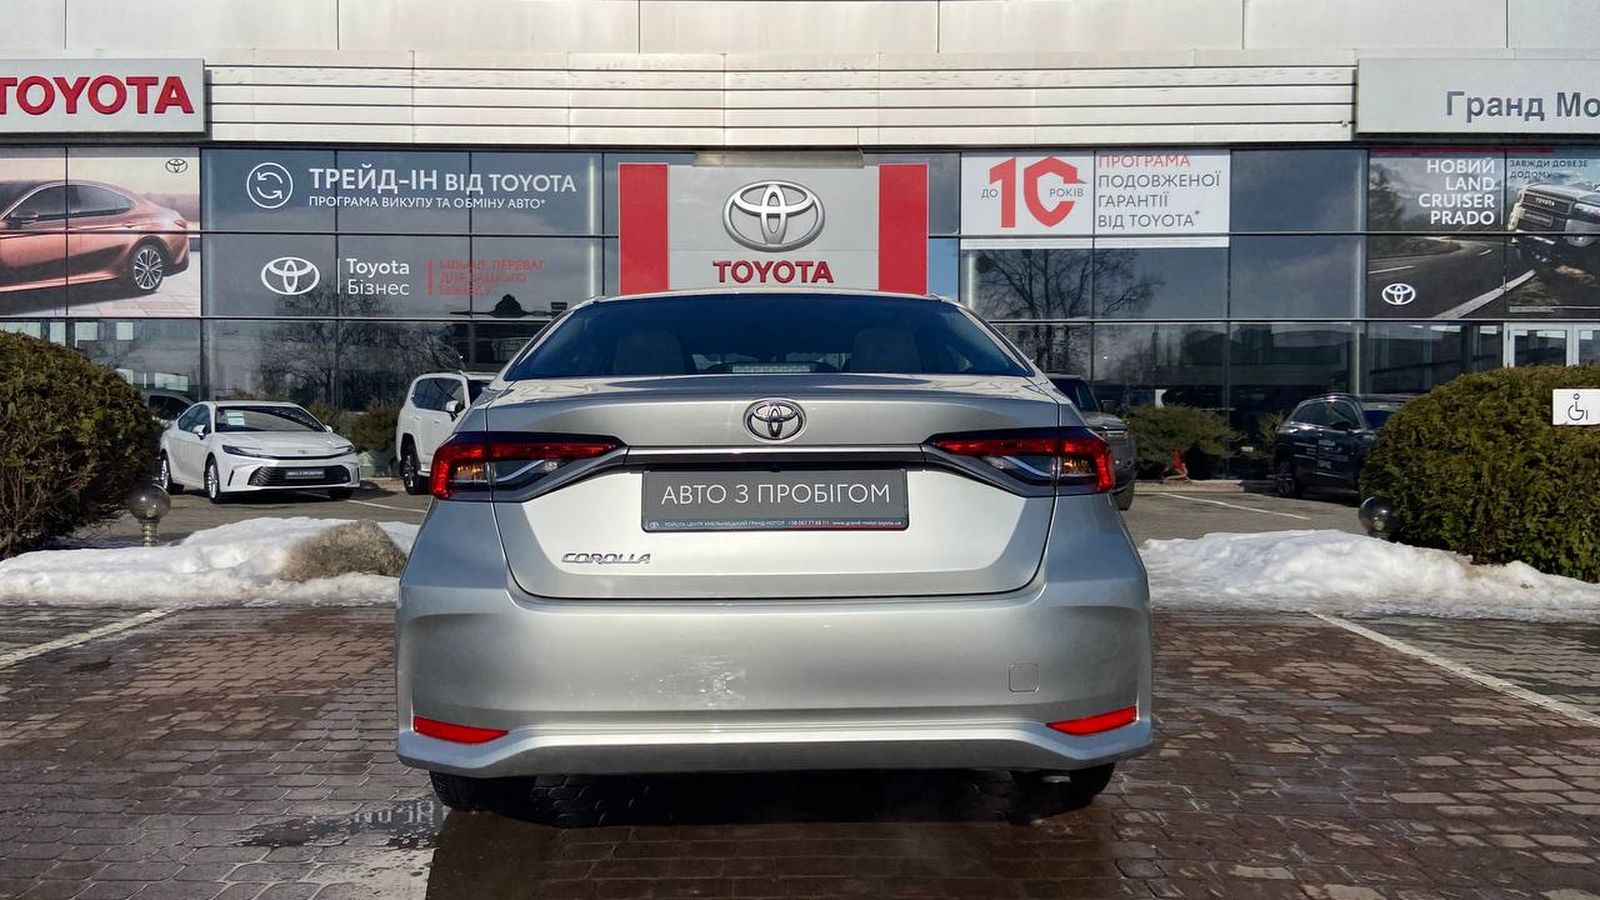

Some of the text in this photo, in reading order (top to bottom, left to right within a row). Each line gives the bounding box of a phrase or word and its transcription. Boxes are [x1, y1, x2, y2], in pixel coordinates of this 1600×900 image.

[1446, 91, 1545, 123] Гранд
[1098, 154, 1191, 169] ПРОГРАМА
[1427, 157, 1496, 174] НОВИЙ
[309, 164, 577, 196] ТРЕЙД-ІН ВІД TOYOTA
[1098, 171, 1222, 190] ПОДОВЖЕНОЇ
[1445, 177, 1495, 191] LAND
[981, 188, 999, 200] ДО
[1049, 187, 1085, 198] РОКІВ
[1098, 192, 1170, 208] ГАРАНТІЇ
[1418, 193, 1495, 208] CRUISER
[309, 197, 379, 209] ПРОГРАМА
[381, 197, 433, 209] ВИКУПУ
[435, 197, 451, 209] ТА
[453, 197, 505, 210] ОБМІНУ
[1098, 214, 1125, 230] ВІД
[1430, 210, 1495, 226] PRADO
[346, 259, 410, 277] Toyota
[712, 260, 834, 284] TOYOTA
[347, 279, 410, 296] Бізнес
[661, 484, 727, 505] АВТО
[757, 483, 890, 504] ПРОБІГОМ
[561, 552, 651, 565] COROLLA
